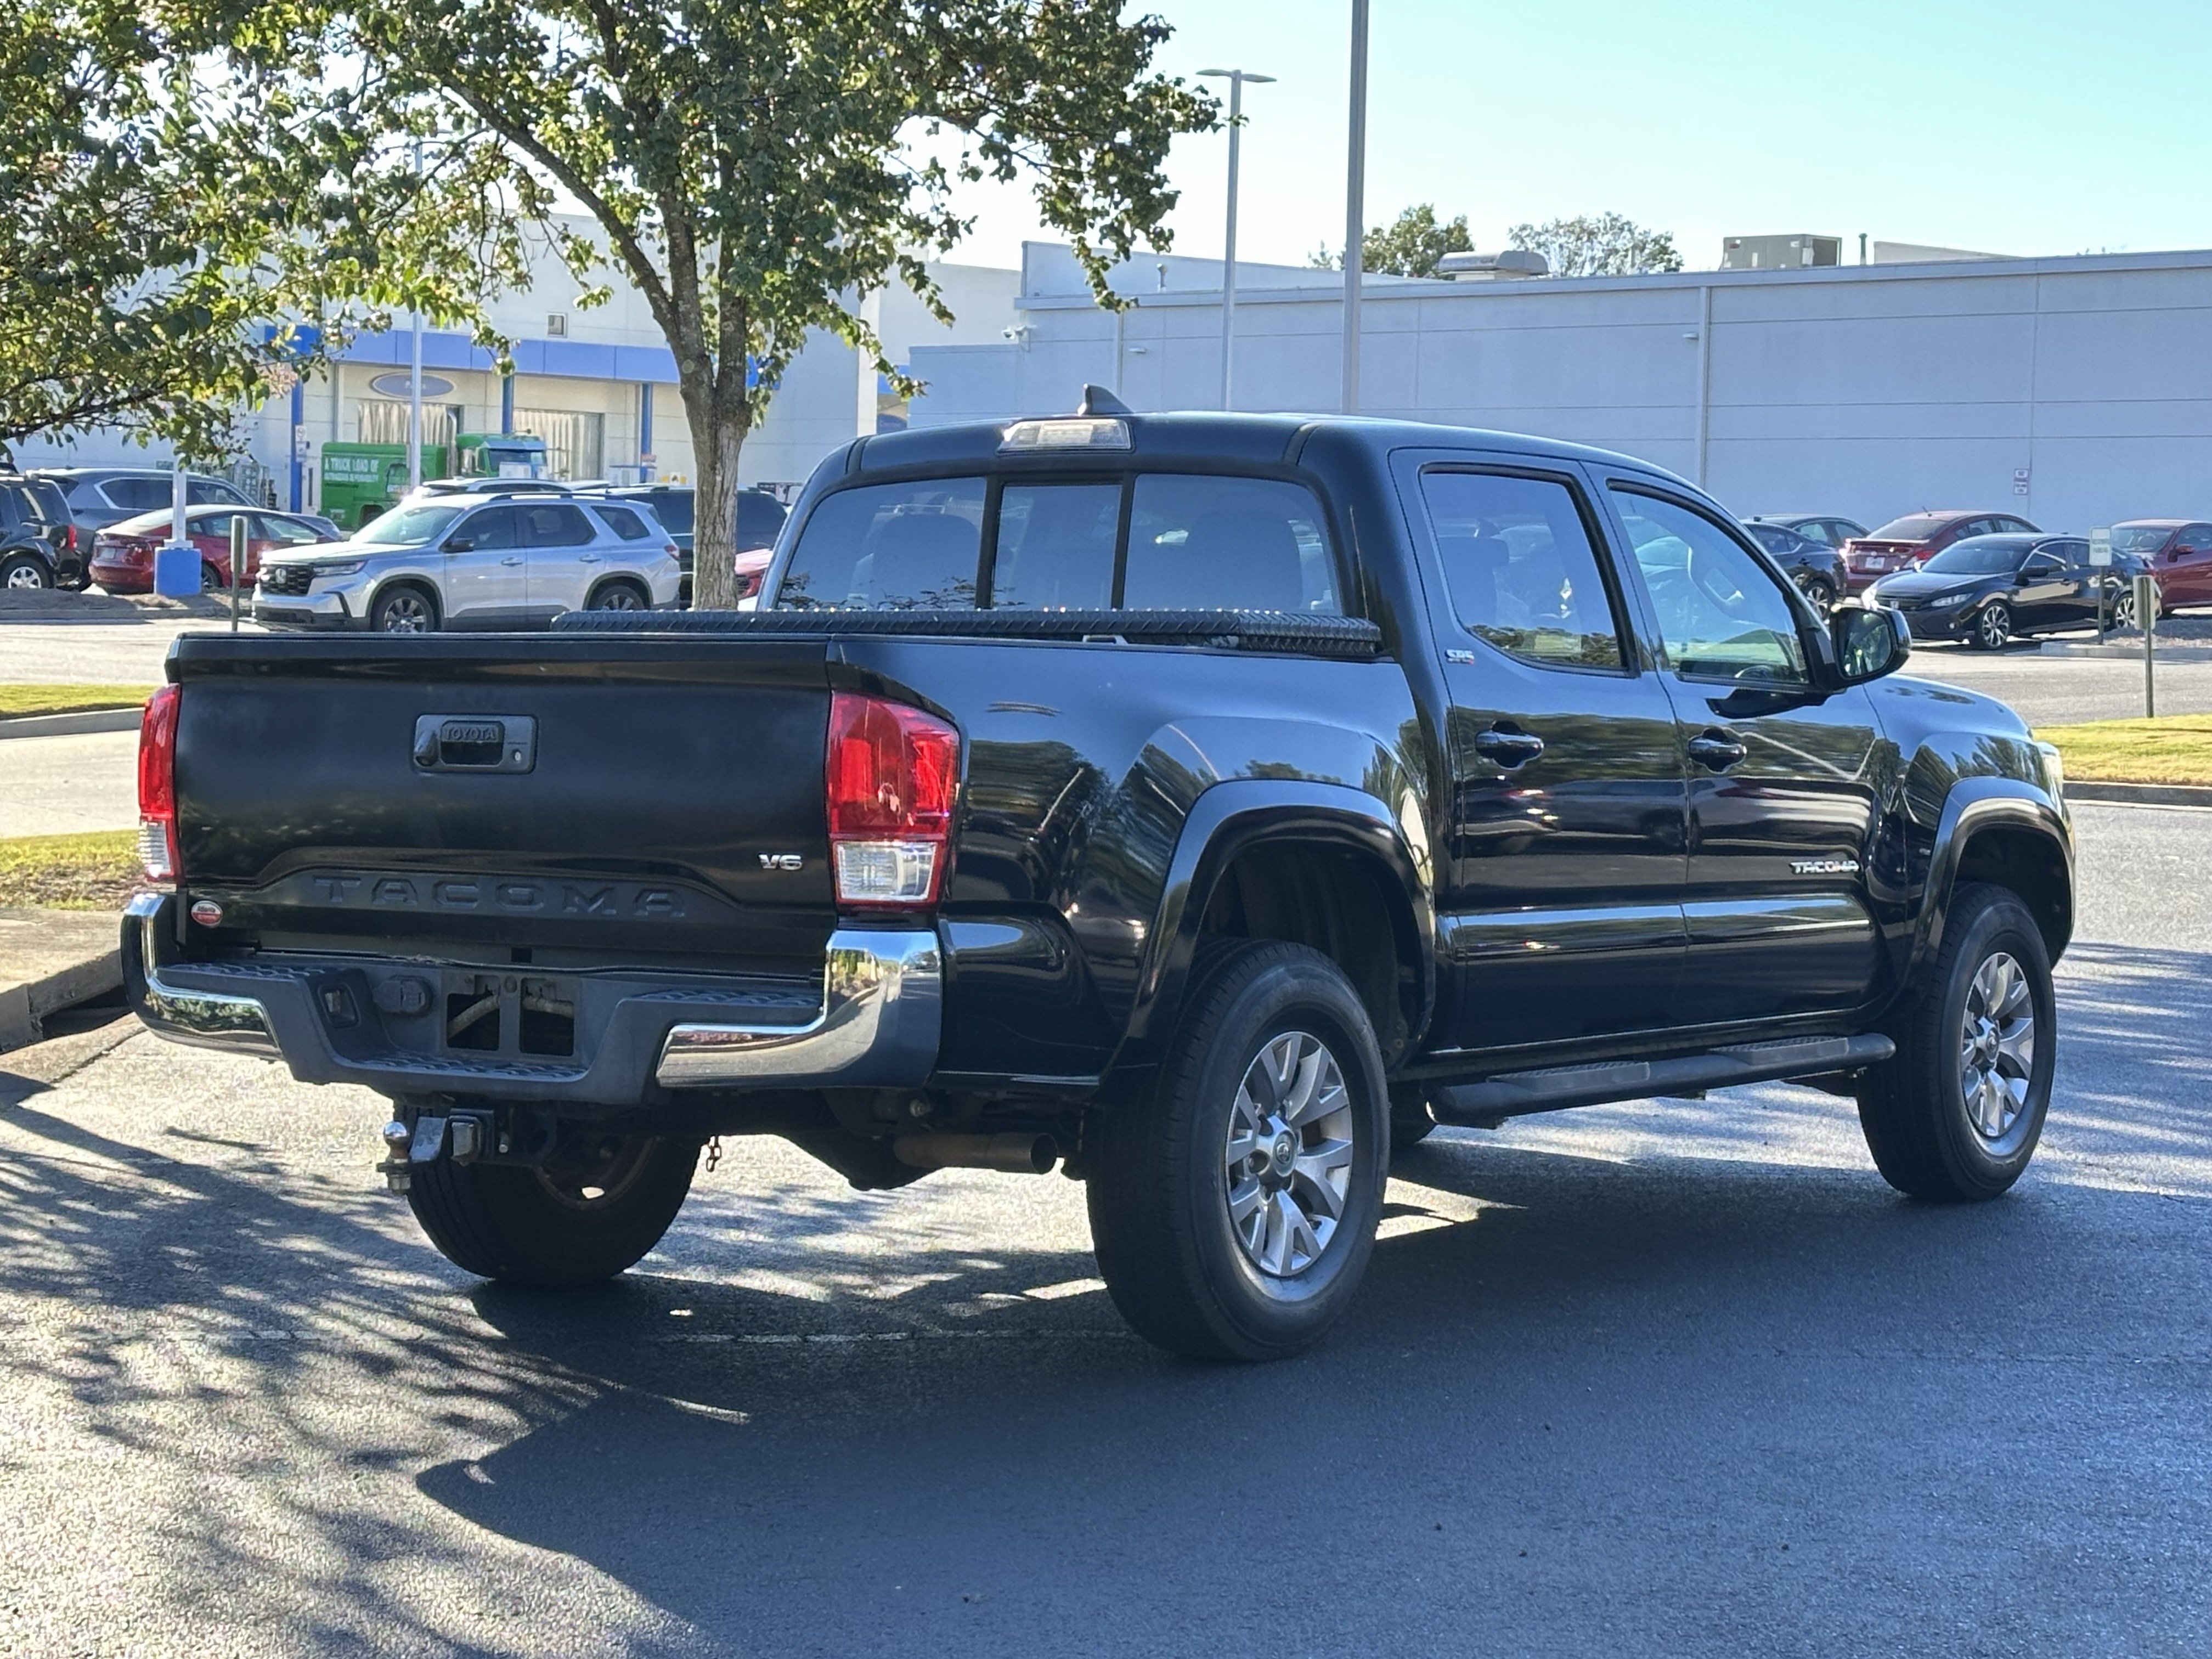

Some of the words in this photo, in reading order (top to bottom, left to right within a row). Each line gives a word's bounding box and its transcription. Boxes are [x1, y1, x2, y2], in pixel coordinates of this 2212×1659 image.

[324, 457, 329, 471] A
[331, 458, 351, 471] TRUCK
[352, 458, 368, 472] LOAD
[370, 459, 380, 473] OF
[446, 727, 495, 740] TOYOTA
[758, 854, 802, 871] V6
[1790, 860, 1859, 873] TACOMA
[313, 877, 686, 918] TACOMA
